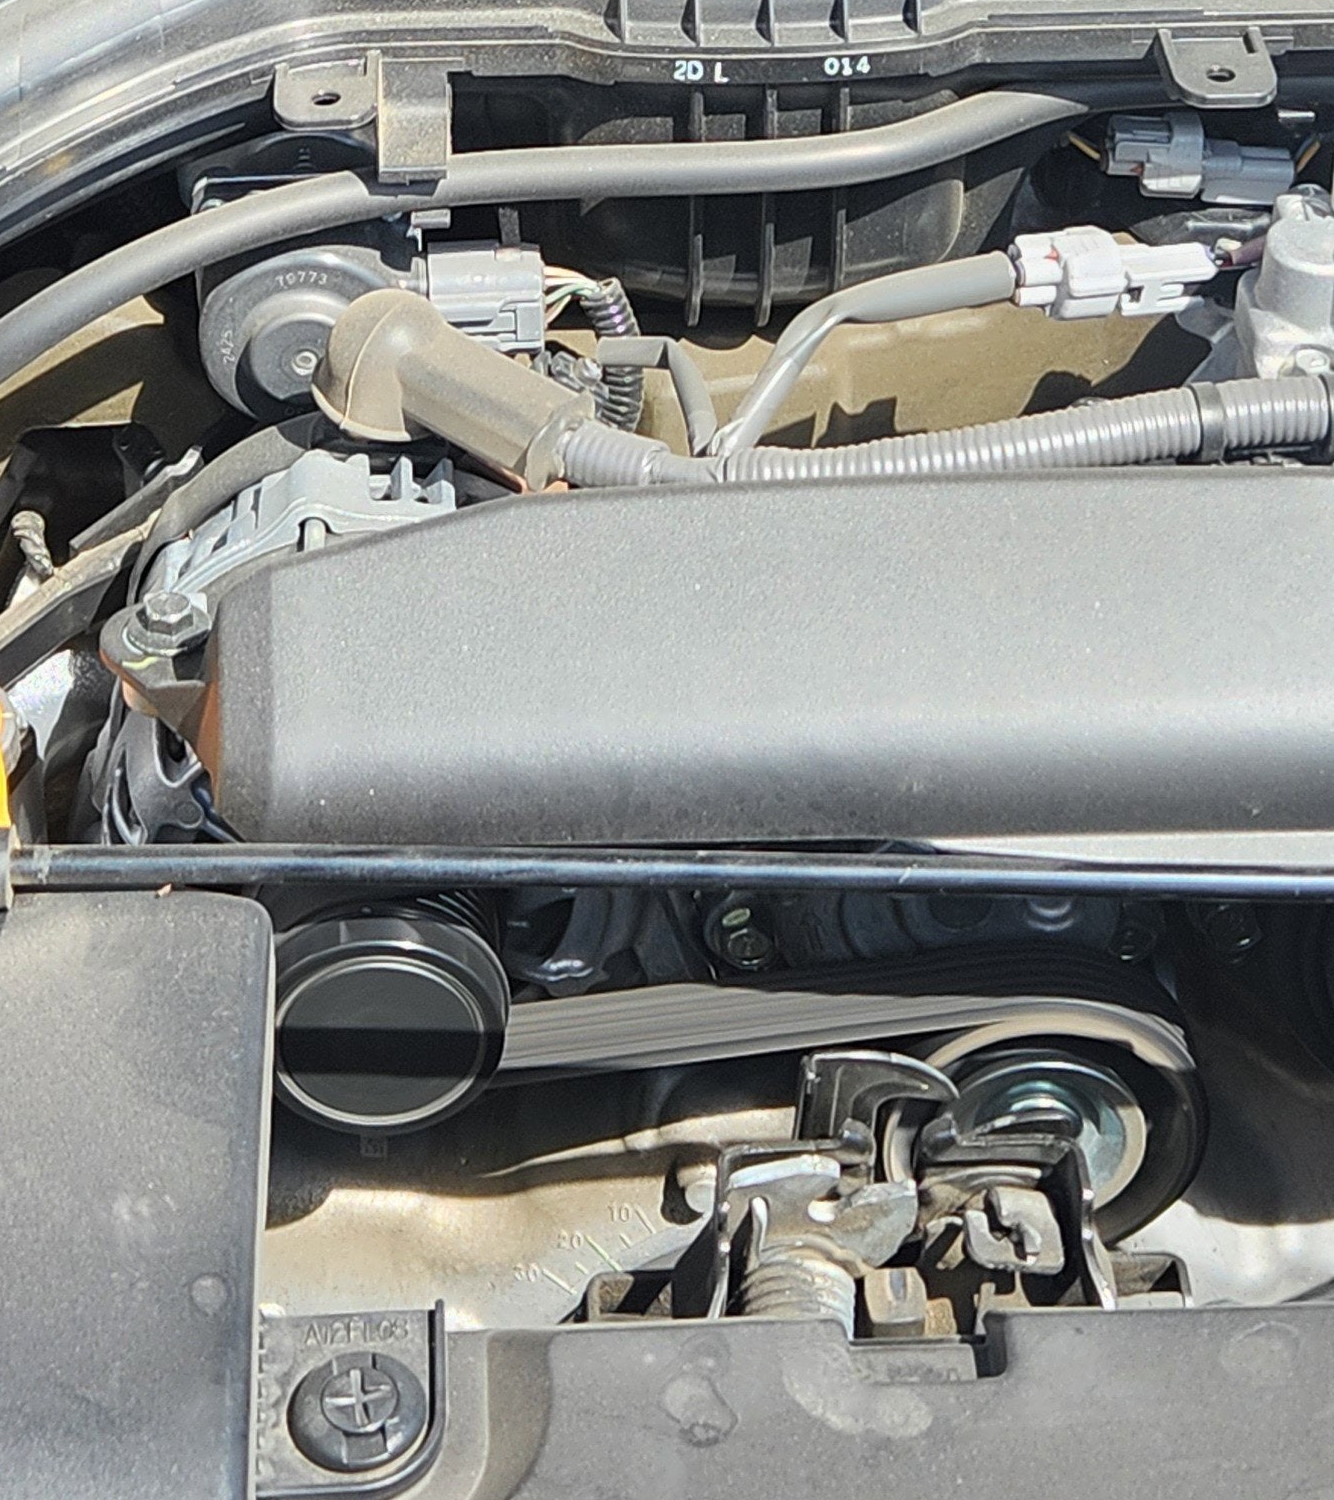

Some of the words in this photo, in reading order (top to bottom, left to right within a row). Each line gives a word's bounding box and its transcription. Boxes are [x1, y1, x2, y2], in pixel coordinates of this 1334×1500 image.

[673, 60, 704, 81] 2D
[714, 61, 729, 83] L
[824, 55, 871, 77] 014
[608, 1202, 632, 1223] 10
